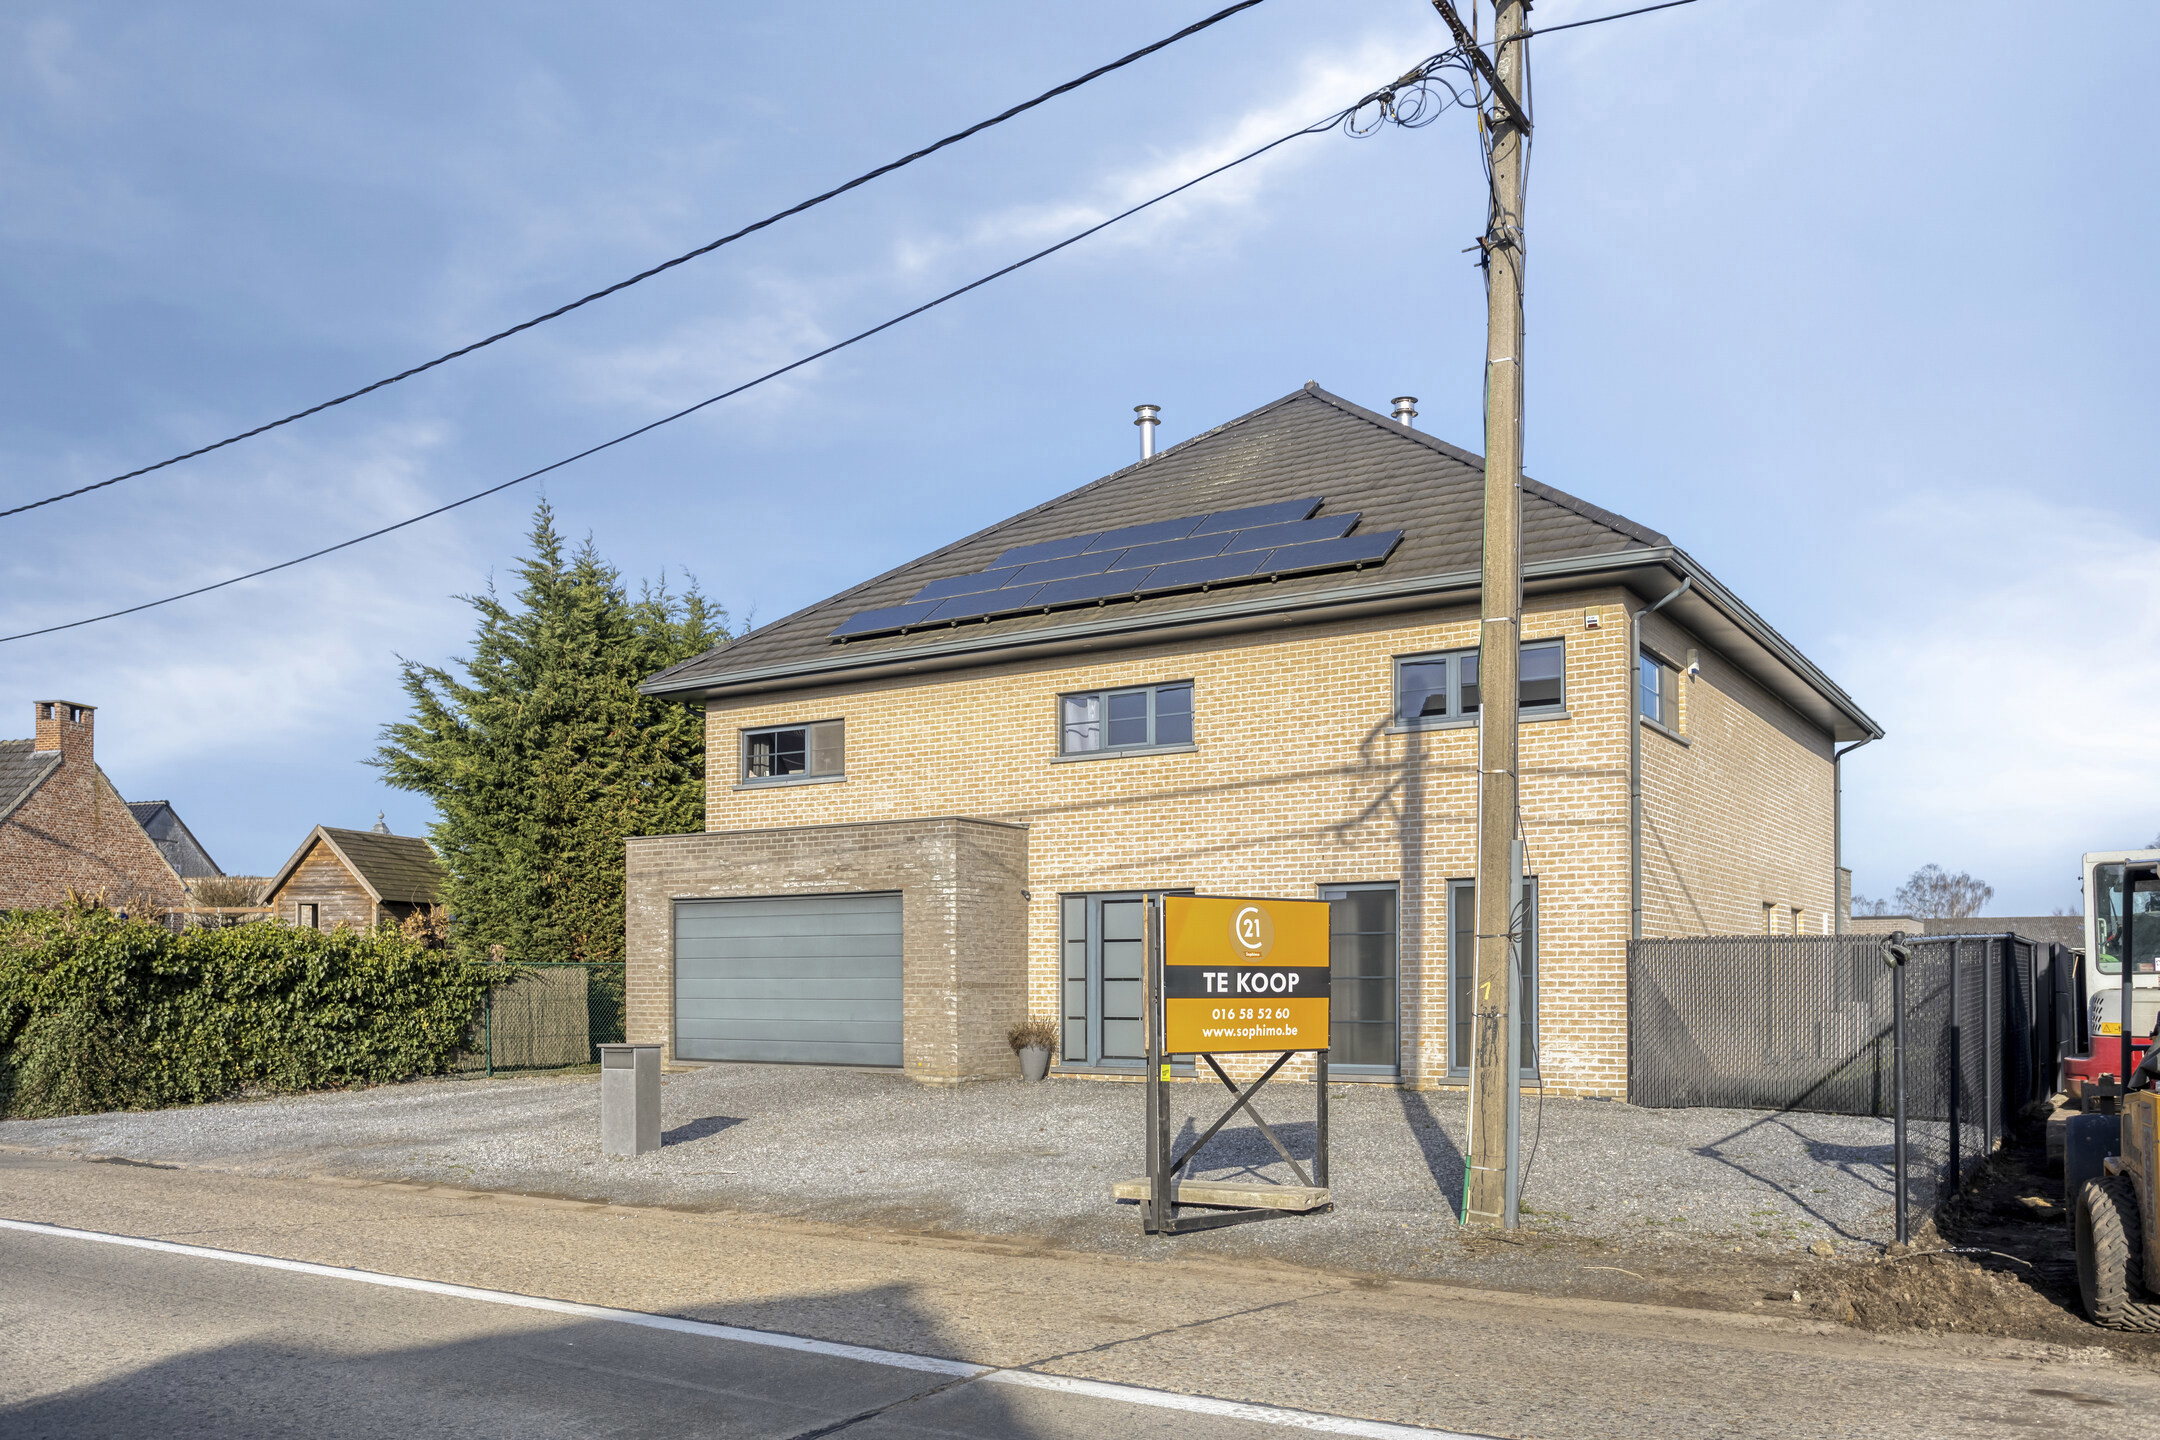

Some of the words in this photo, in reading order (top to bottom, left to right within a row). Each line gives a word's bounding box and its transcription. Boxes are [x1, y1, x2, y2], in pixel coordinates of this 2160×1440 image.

[1203, 972, 1228, 993] TE
[1237, 972, 1300, 993] KOOP
[1212, 1008, 1236, 1020] 016
[1239, 1008, 1254, 1020] 58
[1257, 1008, 1272, 1020] 52
[1275, 1007, 1290, 1019] 60
[1202, 1023, 1298, 1040] www.sophimo.be
